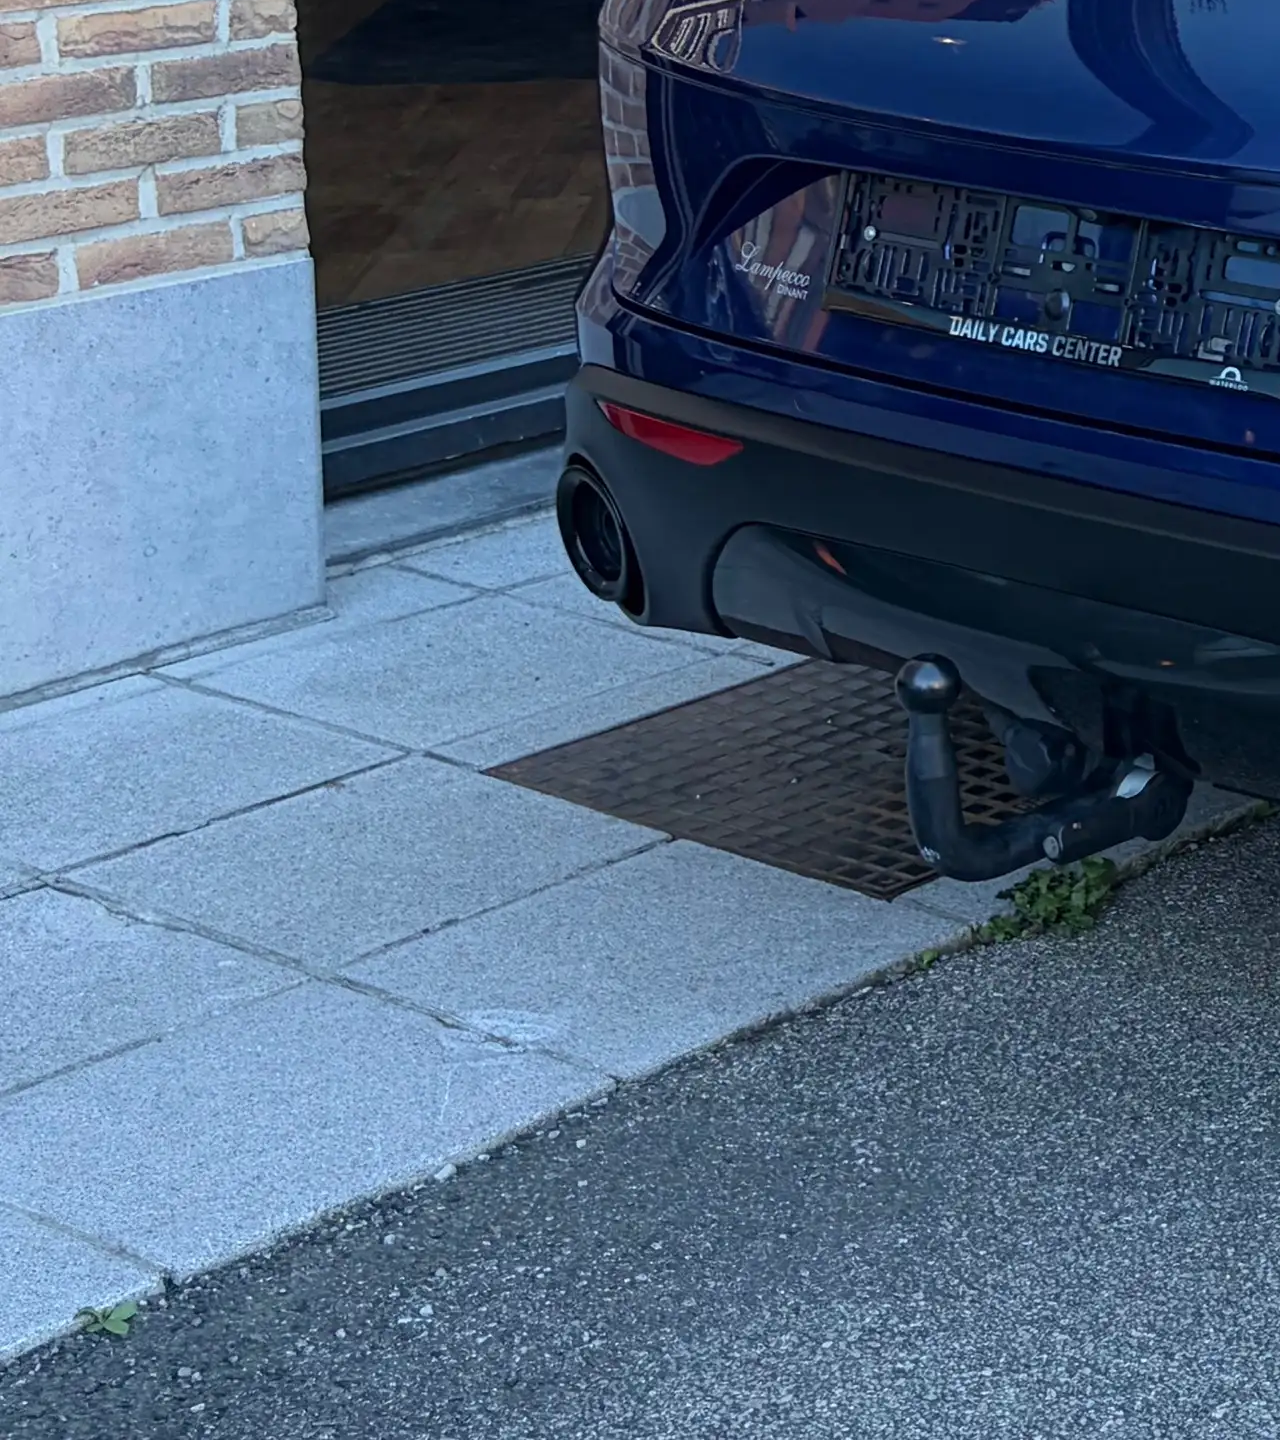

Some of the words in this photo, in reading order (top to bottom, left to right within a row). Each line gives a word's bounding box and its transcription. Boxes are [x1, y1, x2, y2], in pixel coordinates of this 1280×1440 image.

[777, 283, 809, 301] DINANT
[949, 315, 1001, 344] DAILY
[1001, 326, 1049, 353] CARS
[1052, 335, 1122, 368] CENTER
